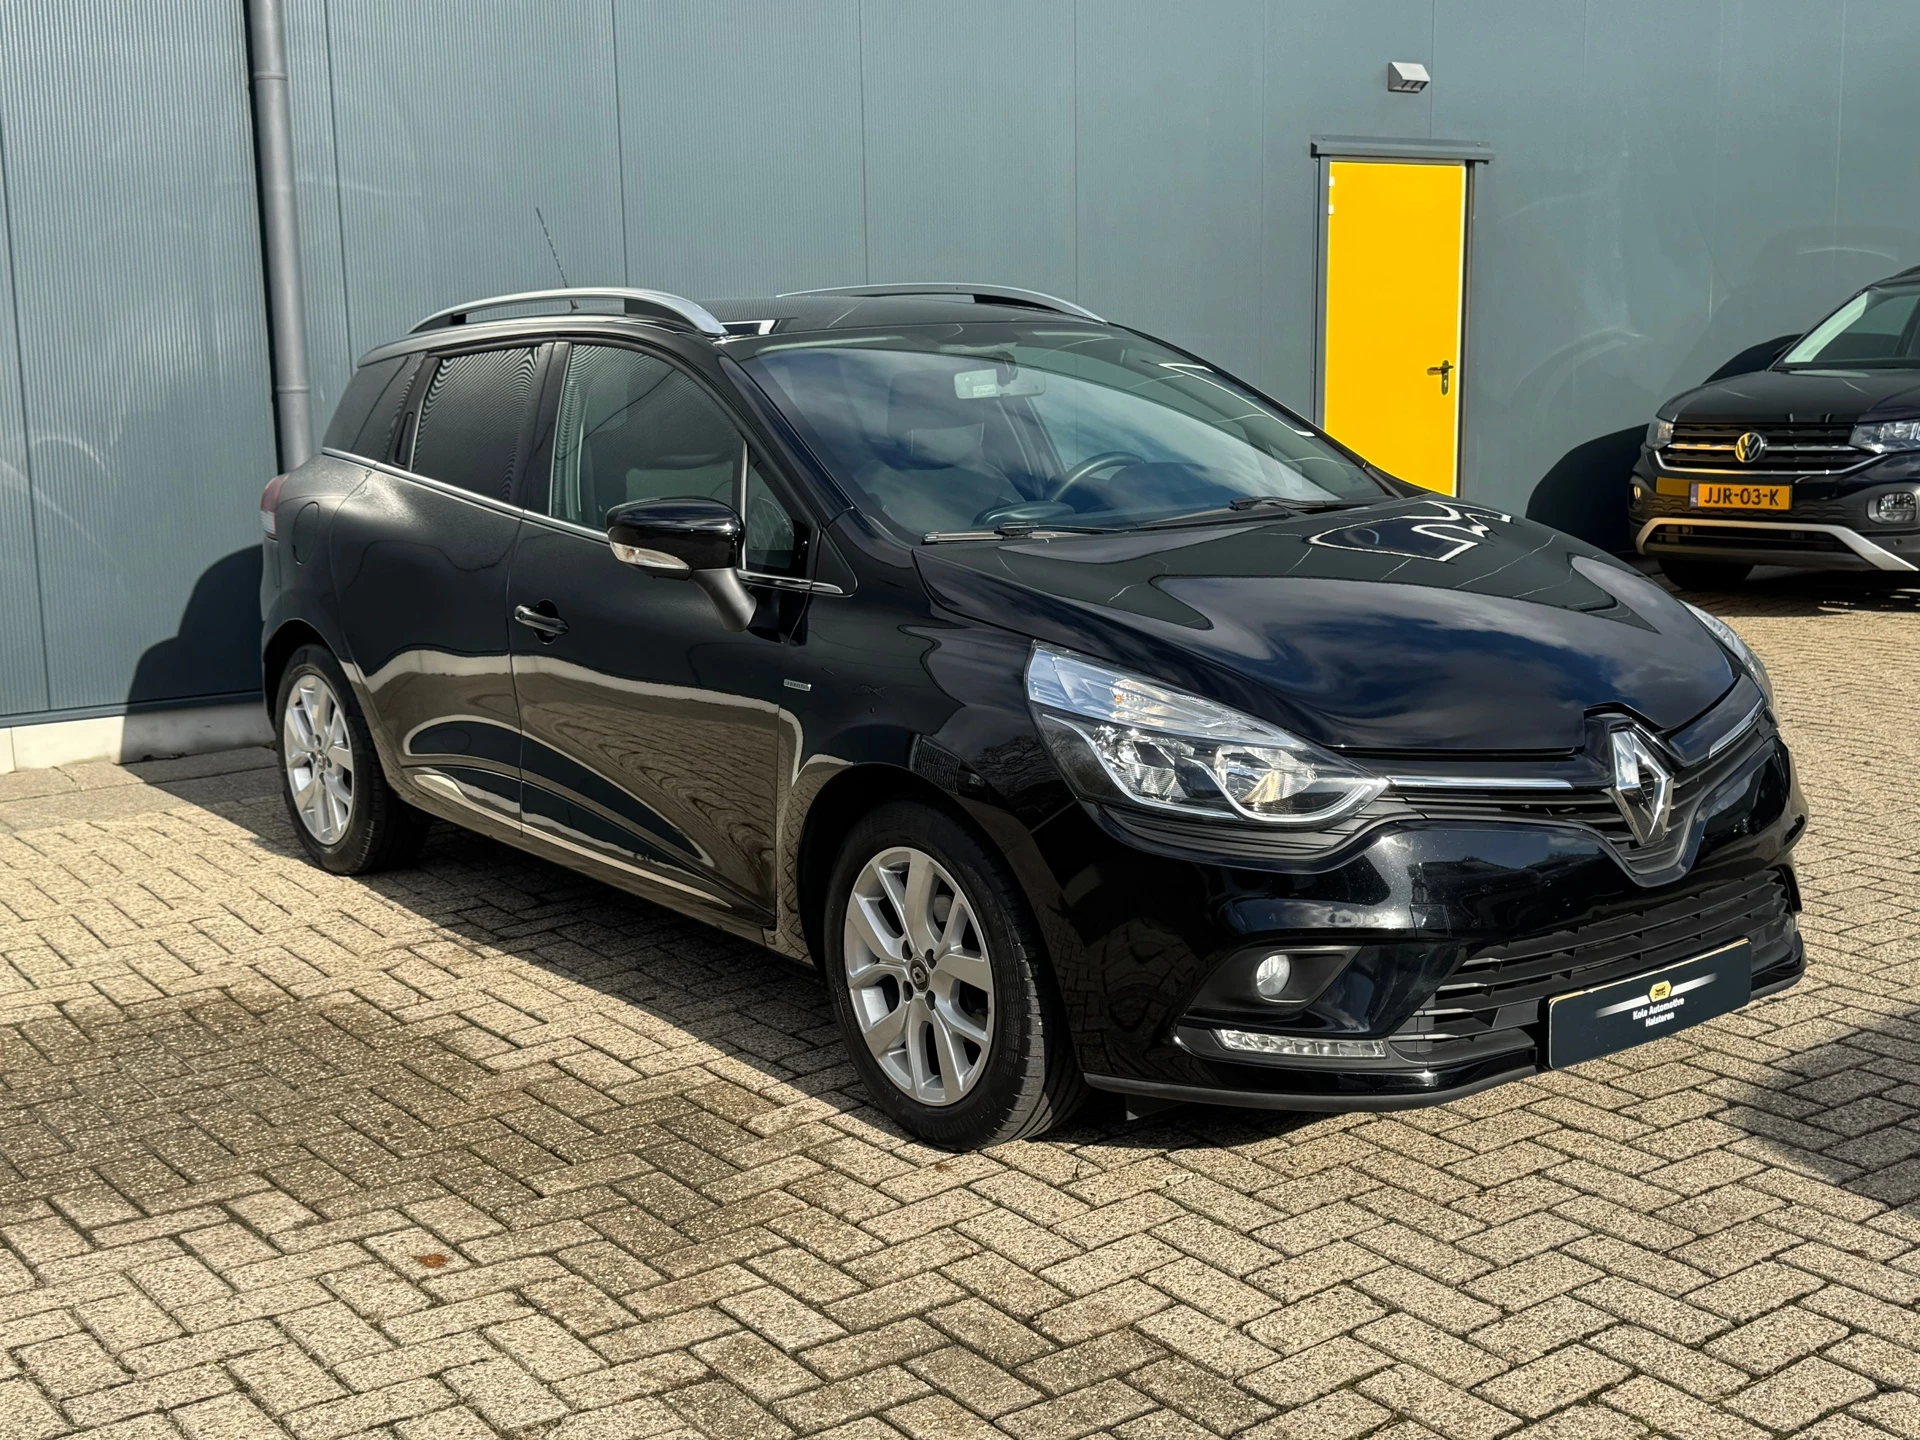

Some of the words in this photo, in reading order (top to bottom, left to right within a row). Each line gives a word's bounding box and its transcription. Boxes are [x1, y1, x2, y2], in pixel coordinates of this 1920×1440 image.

[1704, 487, 1780, 506] JJR-03-K
[1649, 997, 1685, 1015] Automotive
[1645, 1011, 1675, 1027] Halsteren
